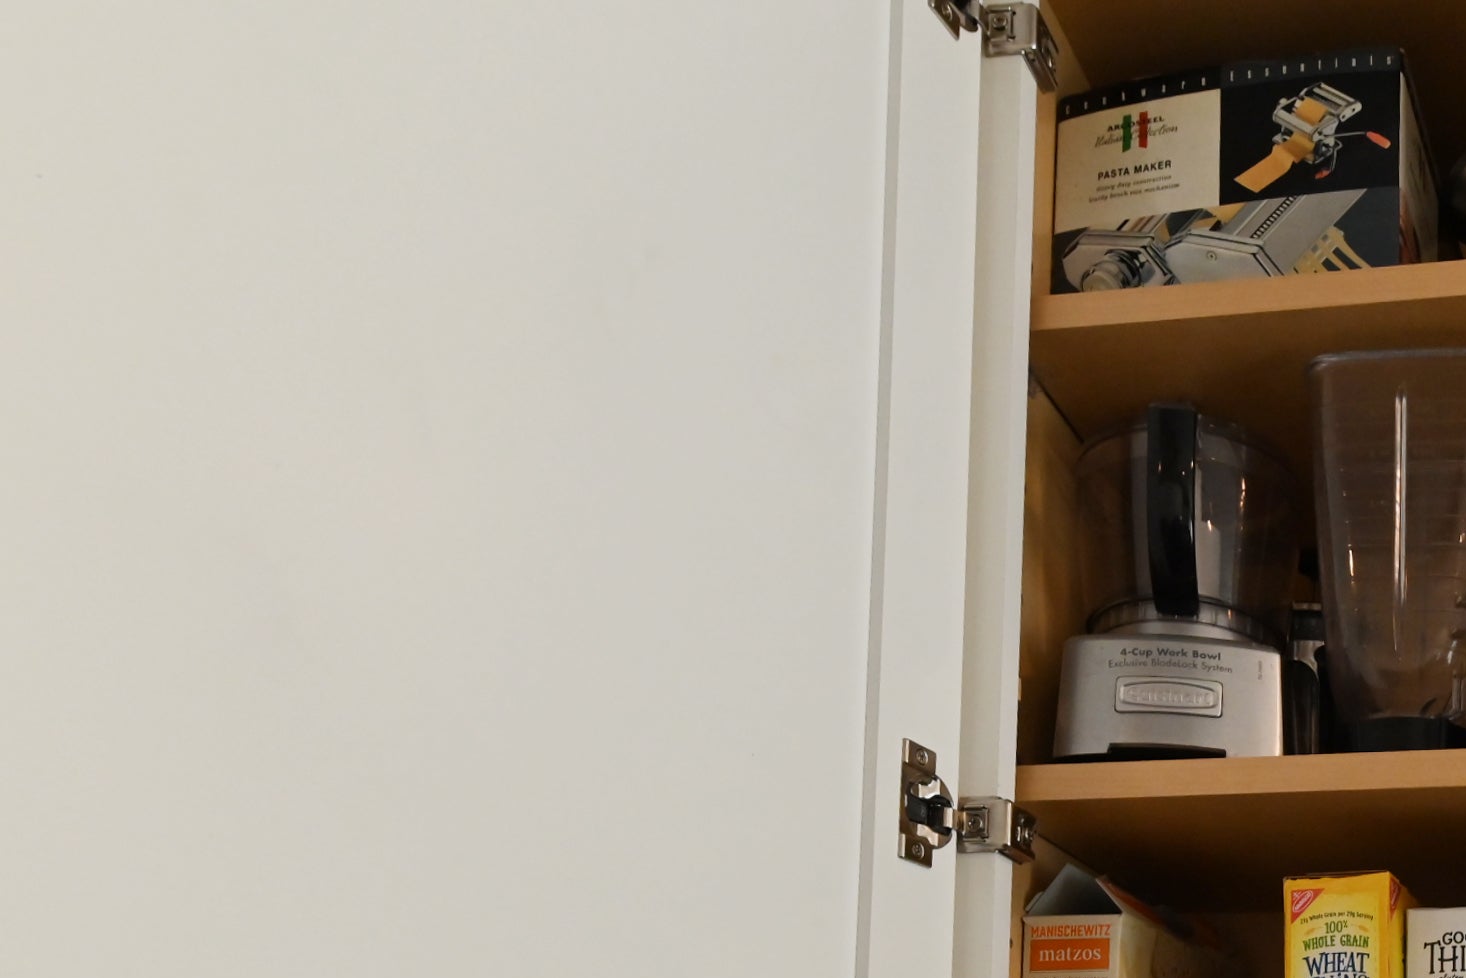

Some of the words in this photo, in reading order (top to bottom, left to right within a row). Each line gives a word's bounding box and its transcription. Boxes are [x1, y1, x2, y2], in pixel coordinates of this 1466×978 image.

[1097, 167, 1130, 180] PASTA
[1134, 160, 1172, 174] MAKER
[1120, 647, 1152, 658] 4-Cup
[1157, 648, 1187, 657] Work
[1192, 650, 1221, 661] Bowl
[1108, 659, 1148, 668] Exclusive
[1201, 661, 1233, 673] System
[1031, 924, 1112, 937] MANISCHEWITZ
[1325, 920, 1348, 933] 100%
[1303, 934, 1335, 951] WHOLE
[1340, 934, 1370, 948] GRAIN
[1039, 947, 1101, 962] matzos
[1302, 952, 1370, 976] WHEAT
